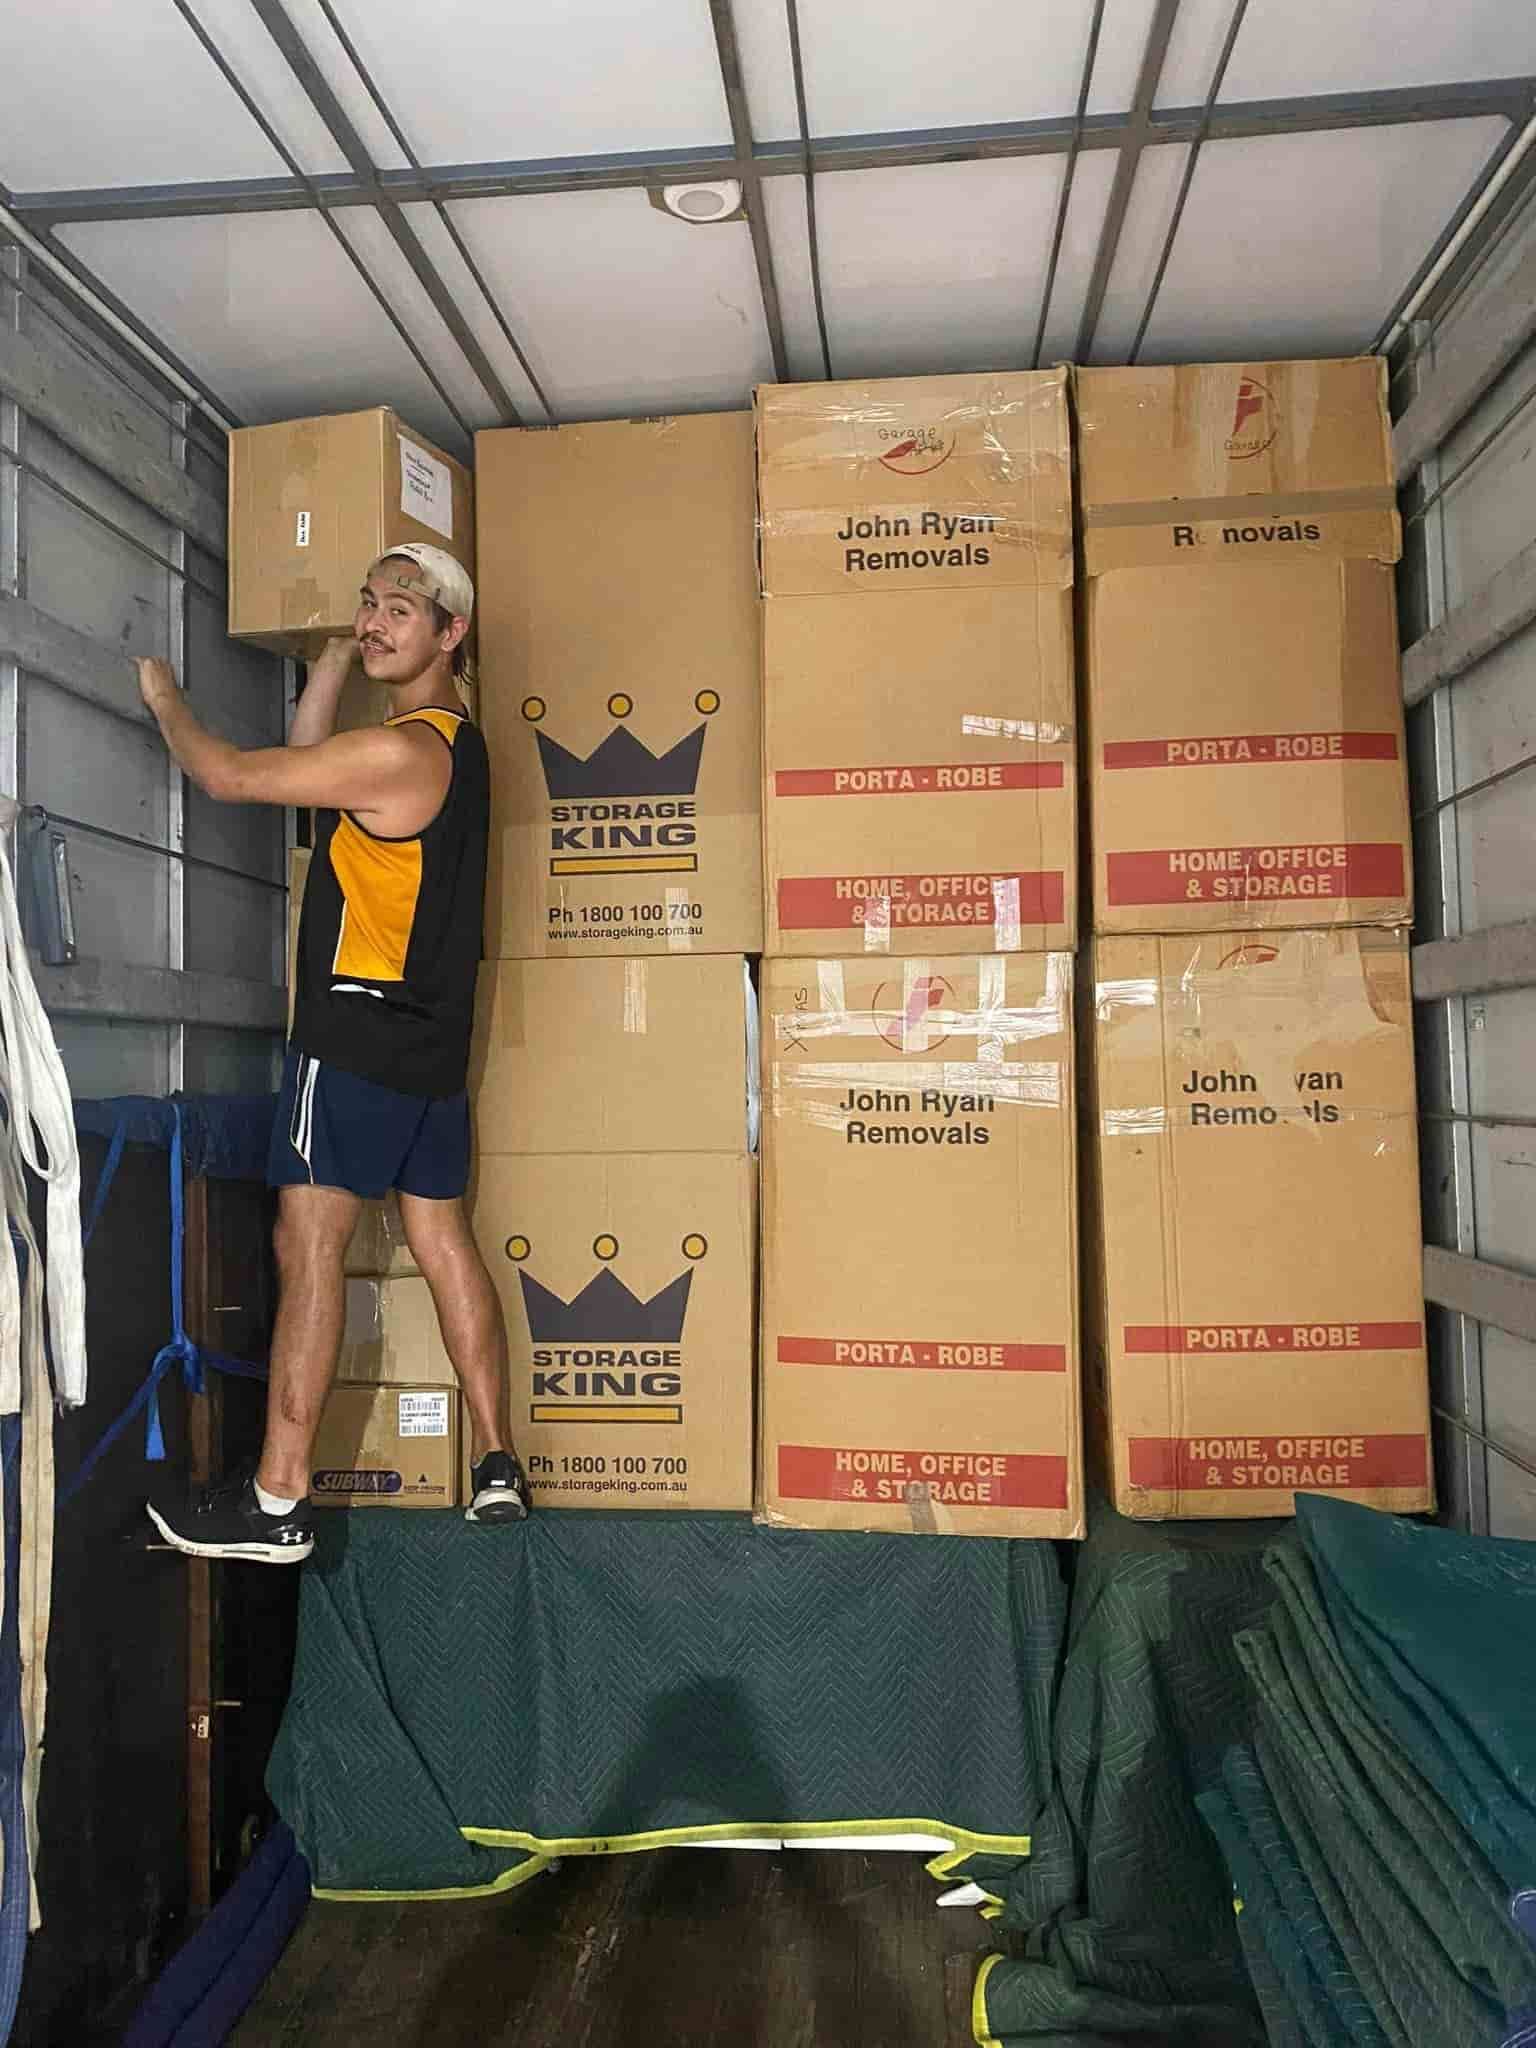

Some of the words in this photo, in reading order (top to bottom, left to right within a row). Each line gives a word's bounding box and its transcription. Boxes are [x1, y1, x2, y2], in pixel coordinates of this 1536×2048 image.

[838, 515, 911, 540] John
[921, 511, 995, 540] Ryan
[846, 543, 990, 572] Removals
[1167, 739, 1251, 762] PORTA
[1275, 736, 1343, 758] ROBE
[834, 769, 915, 791] PORTA
[937, 767, 1003, 787] ROBE
[551, 802, 696, 822] STORAGE
[551, 823, 696, 850] KING
[1258, 847, 1347, 869] OFFICE
[836, 879, 911, 900] HOME,
[1186, 878, 1203, 898] &
[1213, 874, 1333, 897] STORAGE
[549, 907, 574, 924] Ph
[580, 905, 624, 922] 1800
[630, 904, 663, 921] 100
[668, 902, 703, 920] 700
[892, 902, 990, 923] TORAGE
[547, 924, 704, 940] www.storageking.com.au
[1182, 1070, 1257, 1093] John
[1294, 1071, 1343, 1092] yan
[839, 1089, 911, 1112] John
[921, 1088, 995, 1118] Ryan
[847, 1121, 990, 1145] Removals
[1186, 1328, 1271, 1349] PORTA
[1293, 1327, 1361, 1347] ROBE
[533, 1350, 681, 1367] STORAGE
[834, 1343, 915, 1364] PORTA
[937, 1345, 1004, 1366] ROBE
[533, 1372, 681, 1396] KING
[1189, 1439, 1268, 1463] HOME,
[1277, 1438, 1365, 1458] OFFICE
[528, 1456, 554, 1473] Ph
[561, 1456, 606, 1473] 1800
[612, 1457, 646, 1473] 100
[652, 1458, 687, 1474] 700
[835, 1451, 912, 1478] HOME,
[919, 1454, 1007, 1476] OFFICE
[1205, 1465, 1223, 1485] &
[1232, 1465, 1350, 1485] STORAGE
[316, 1471, 398, 1491] SUBWAY
[527, 1479, 688, 1493] www.storageking.com.au
[851, 1479, 868, 1497] &
